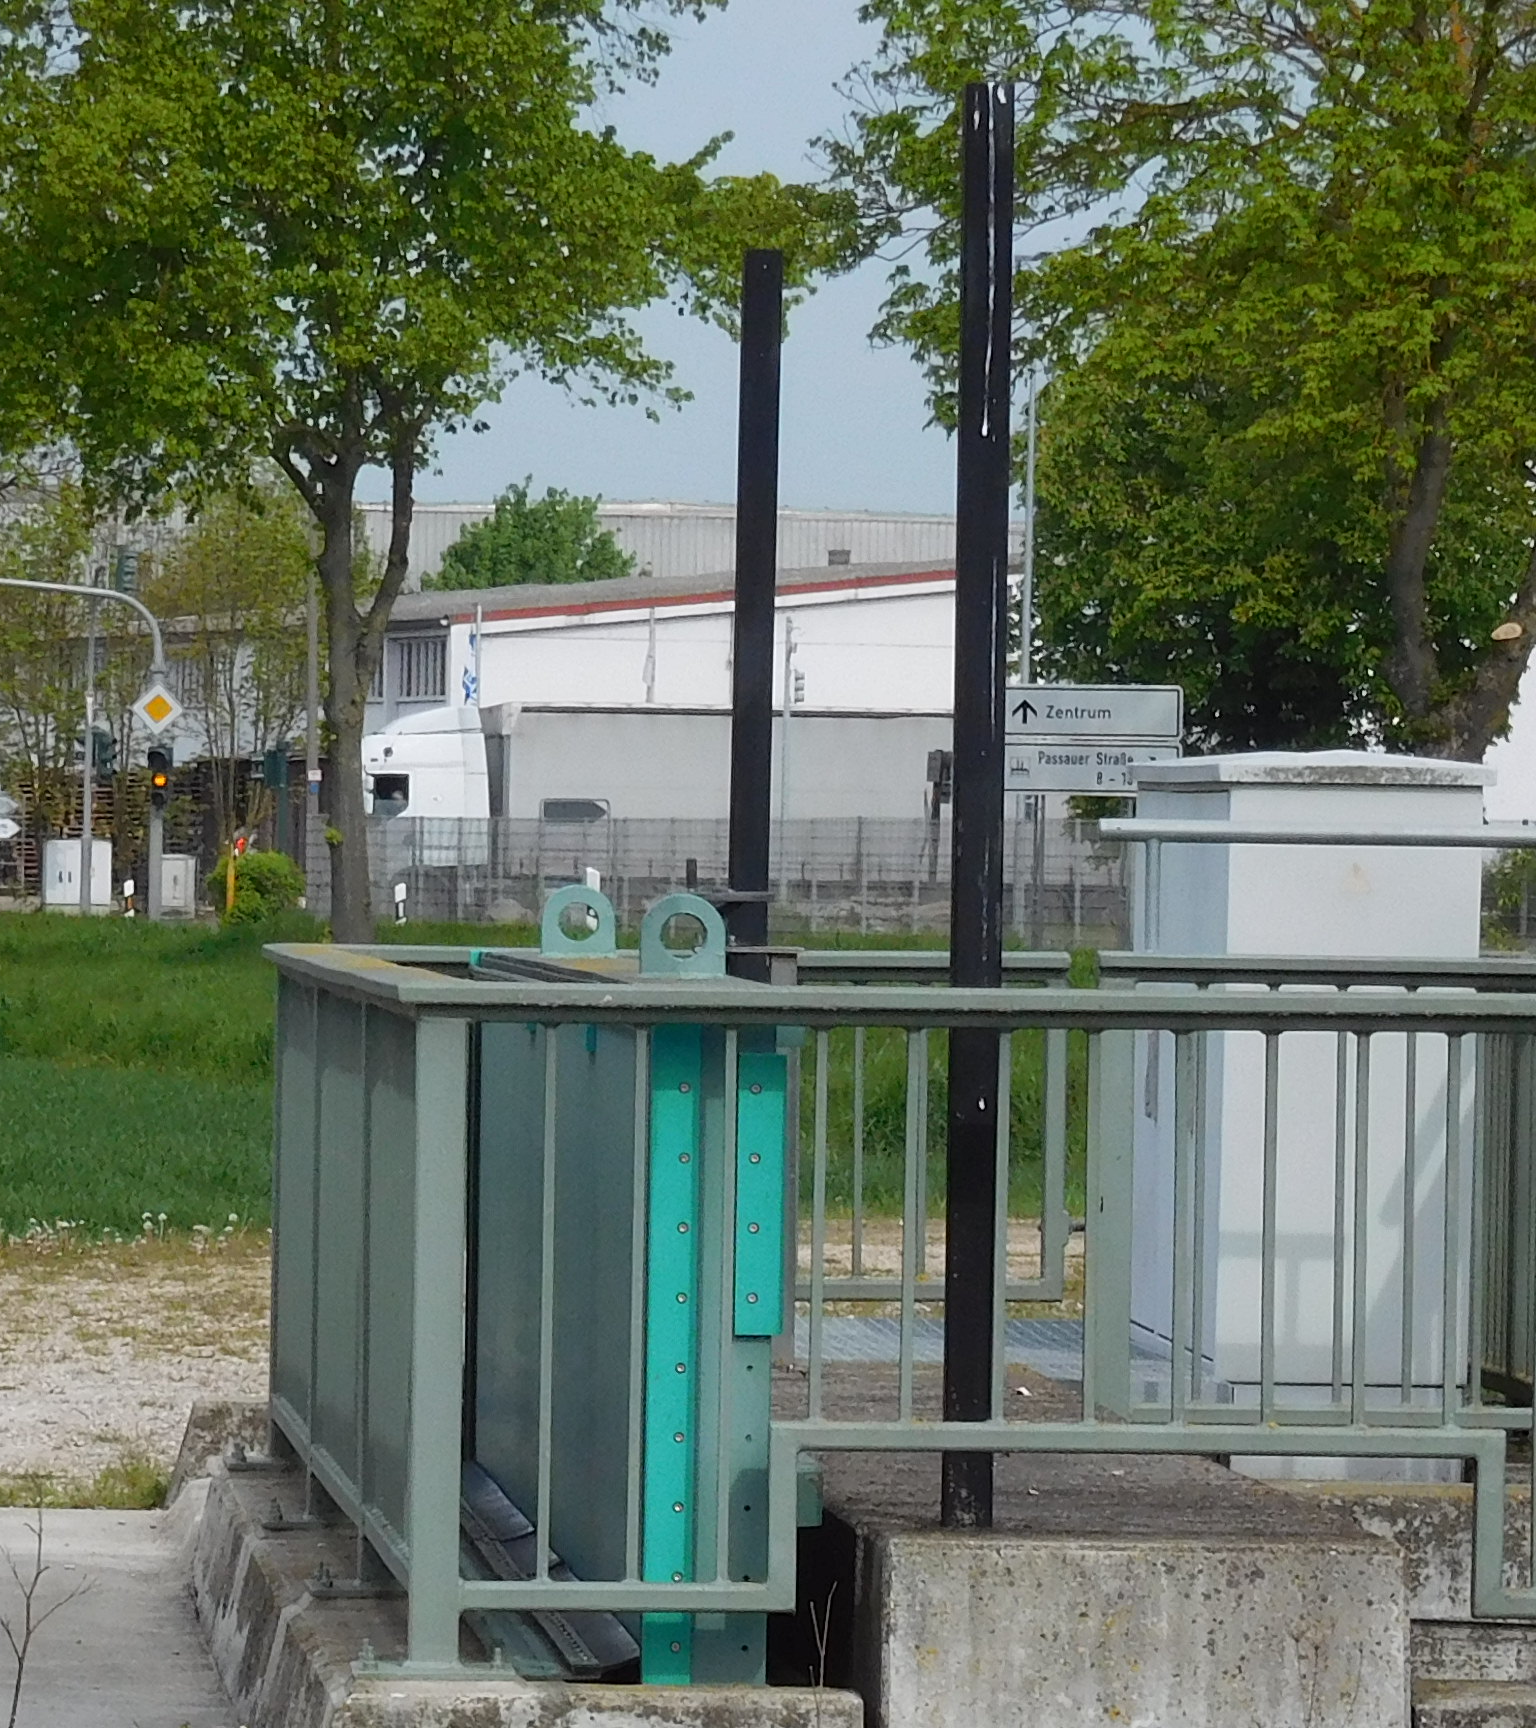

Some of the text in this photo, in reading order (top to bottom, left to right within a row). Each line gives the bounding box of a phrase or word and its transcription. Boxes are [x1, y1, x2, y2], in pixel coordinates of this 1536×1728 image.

[1045, 705, 1112, 719] Zentrum
[1038, 751, 1134, 766] Passauer Straße
[1096, 771, 1103, 786] 8
